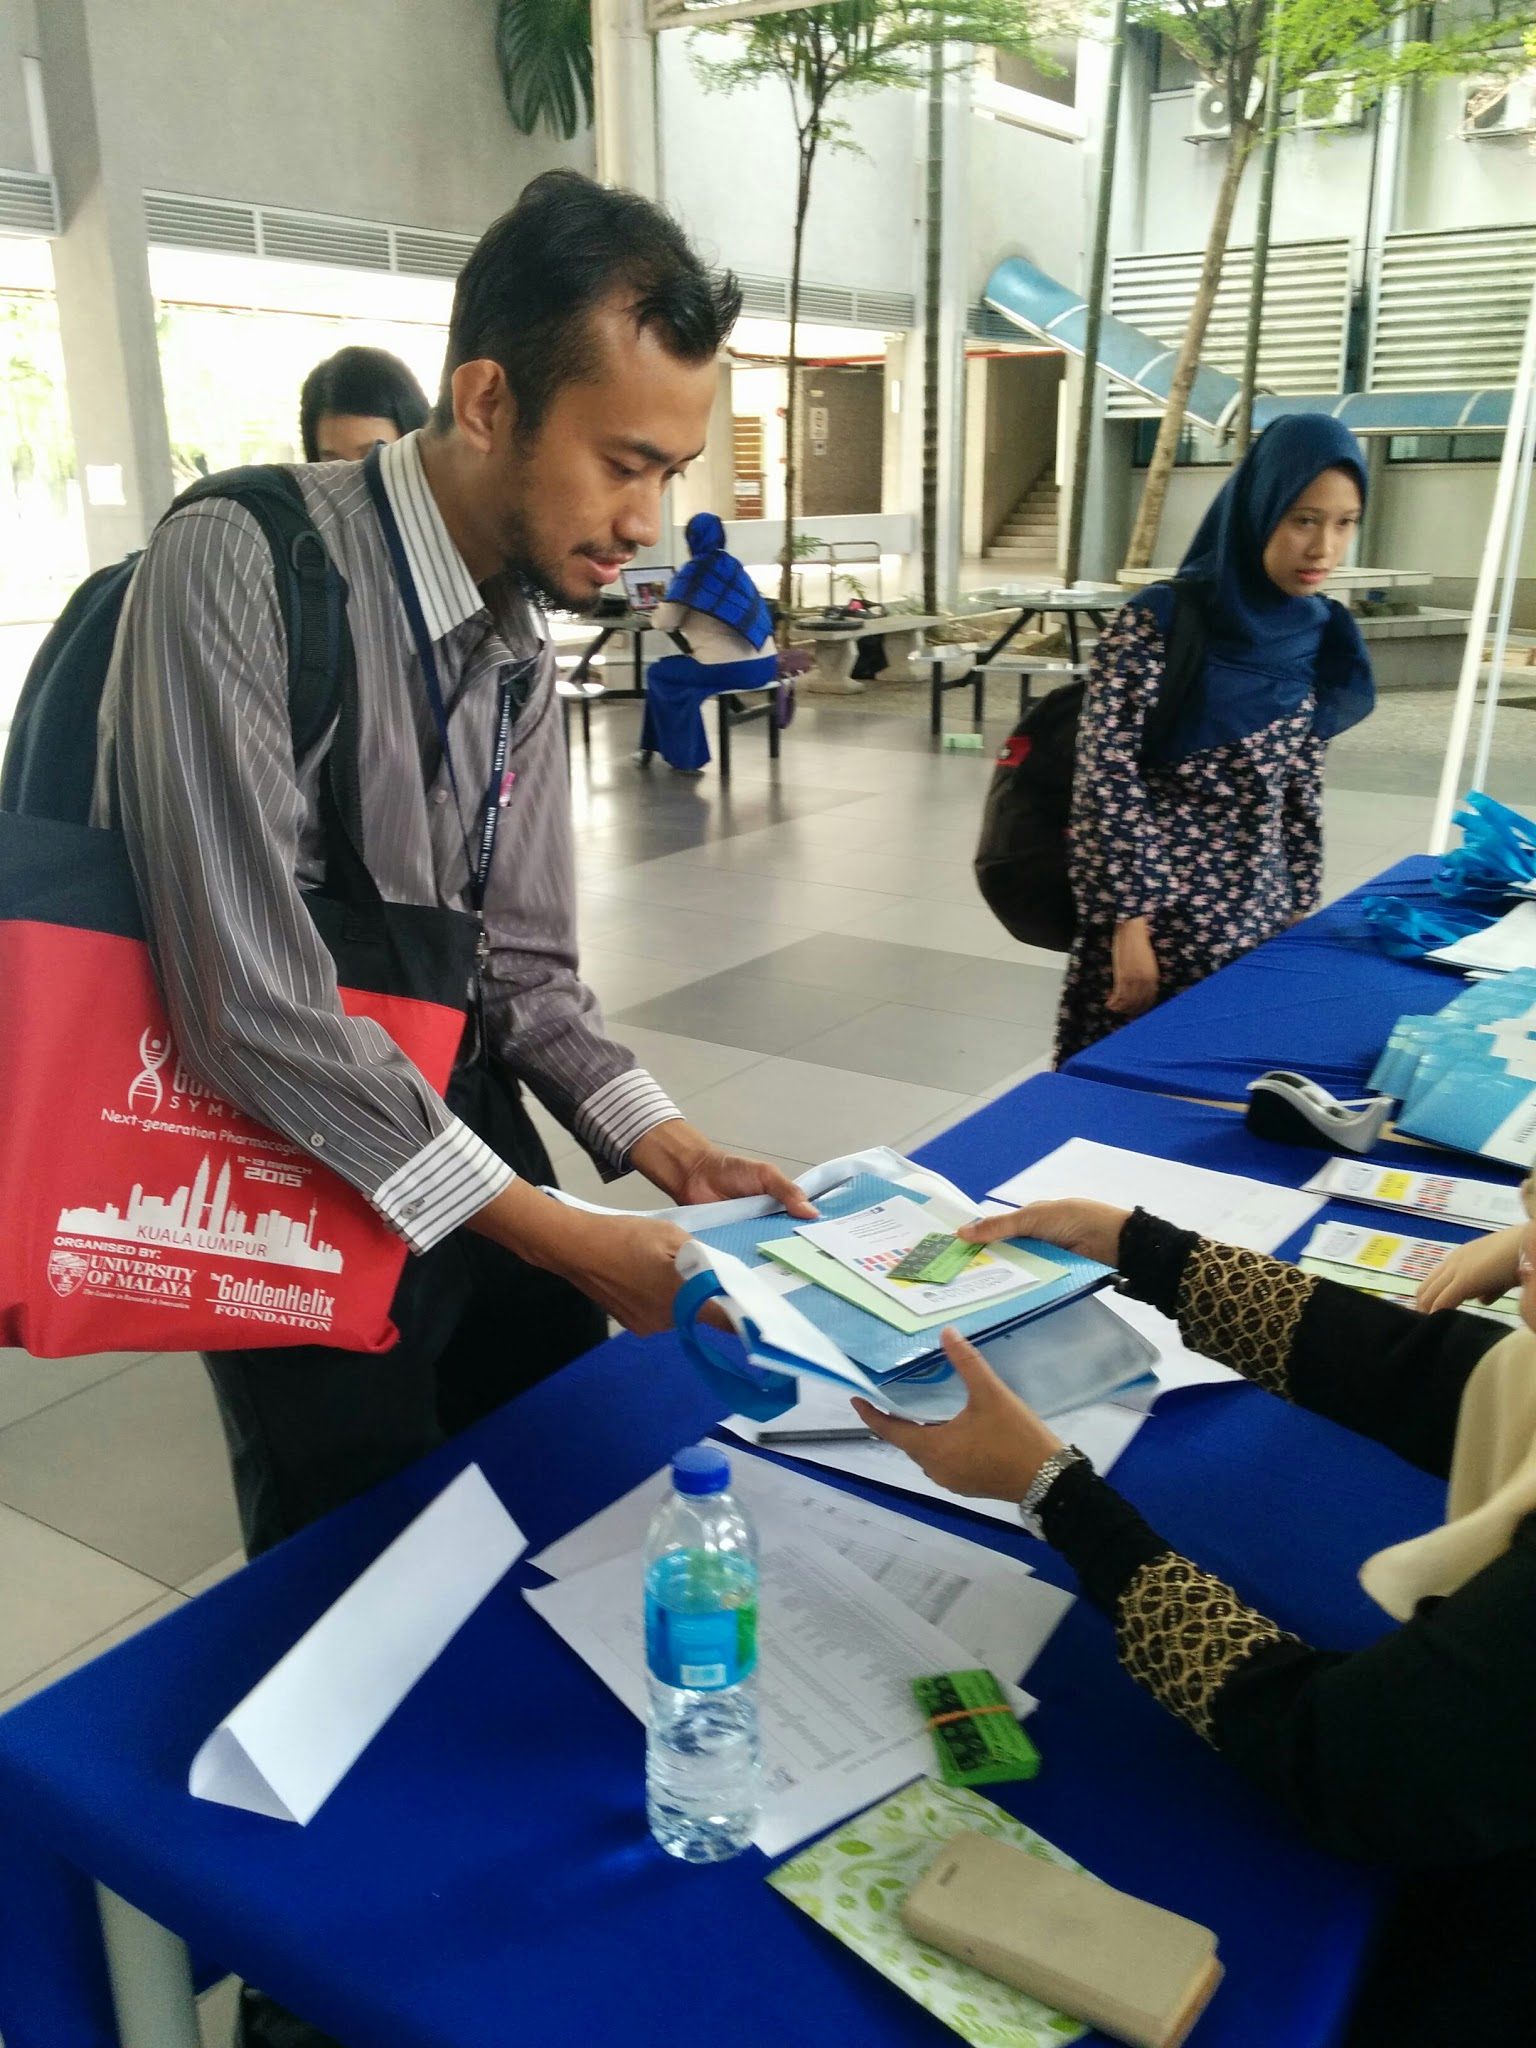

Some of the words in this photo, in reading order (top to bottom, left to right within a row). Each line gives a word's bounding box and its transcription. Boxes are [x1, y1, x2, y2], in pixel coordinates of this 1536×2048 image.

[101, 1108, 217, 1141] Next-generation
[244, 1166, 303, 1188] 2015
[53, 1235, 137, 1255] ORGANISED
[137, 1247, 162, 1260] BY:
[136, 1225, 193, 1247] KUALA
[198, 1235, 268, 1258] LUMPUR
[90, 1254, 198, 1283] UNIVERSITY
[87, 1270, 115, 1286] OF
[115, 1273, 193, 1298] MALAYA
[218, 1273, 335, 1318] GoldenHelix
[215, 1304, 332, 1332] FOUNDATION
